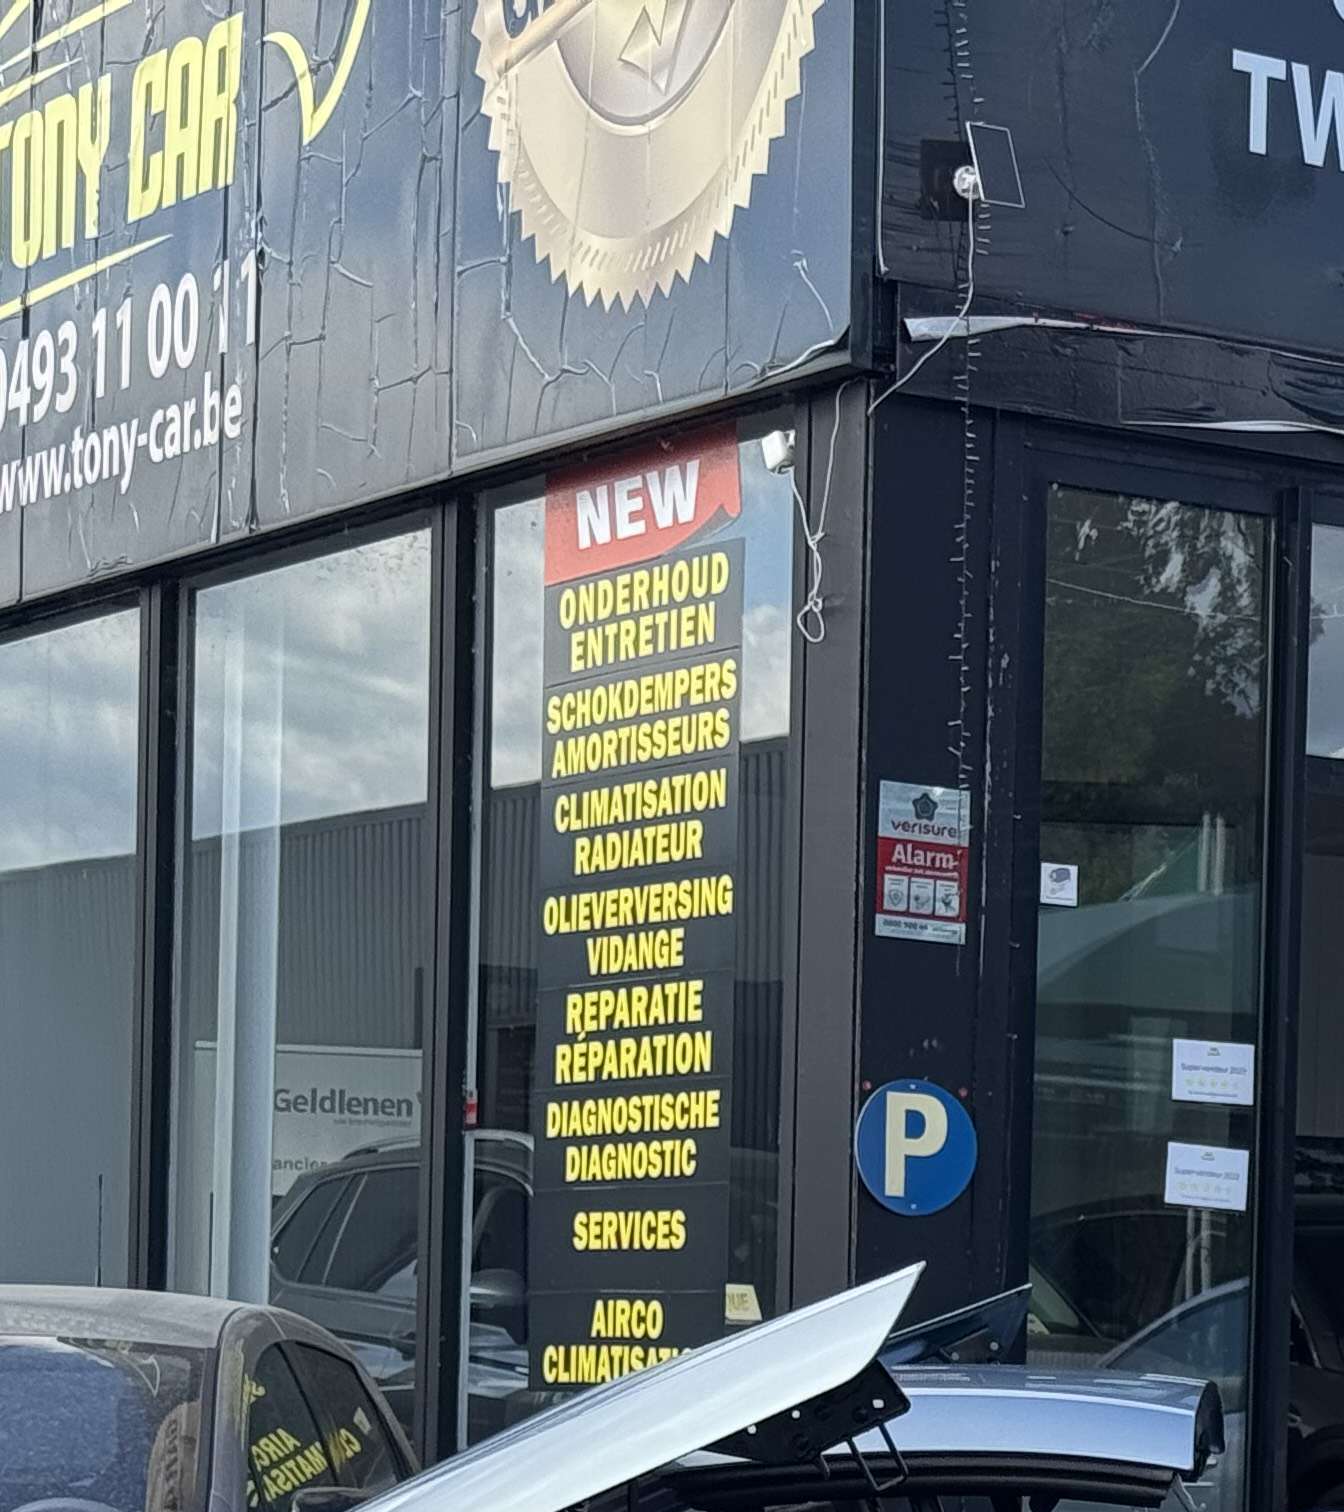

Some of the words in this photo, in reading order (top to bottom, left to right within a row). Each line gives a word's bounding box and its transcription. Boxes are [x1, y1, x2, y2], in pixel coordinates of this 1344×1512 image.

[0, 73, 111, 269] ONY
[127, 12, 244, 224] CAR
[91, 296, 132, 398] 11
[146, 272, 199, 379] 00
[0, 371, 243, 514] www.tony-car.be
[575, 460, 700, 550] NEW
[559, 551, 729, 630] ONDERHOUD
[569, 602, 715, 672] ENTRETIEN
[547, 659, 737, 733] SCHOKDEMPERS
[551, 708, 730, 778] AMORTISSEURS
[555, 768, 727, 833] CLIMATISATION
[574, 821, 703, 875] RADIATEUR
[891, 820, 958, 838] verisure
[892, 843, 954, 869] Alarm
[543, 875, 733, 935] OLIEVERVERSING
[587, 928, 684, 976] VIDANGE
[566, 979, 703, 1035] REPARATIE
[554, 1031, 712, 1085] RÉPARATION
[274, 1088, 413, 1118] Geldlenen
[546, 1088, 720, 1140] DIAGNOSTISCHE
[565, 1138, 697, 1184] DIAGNOSTIC
[885, 1091, 948, 1197] P
[572, 1209, 686, 1252] SERVICES
[590, 1300, 664, 1339] AIRCO
[543, 1345, 693, 1384] CLIMATISA
